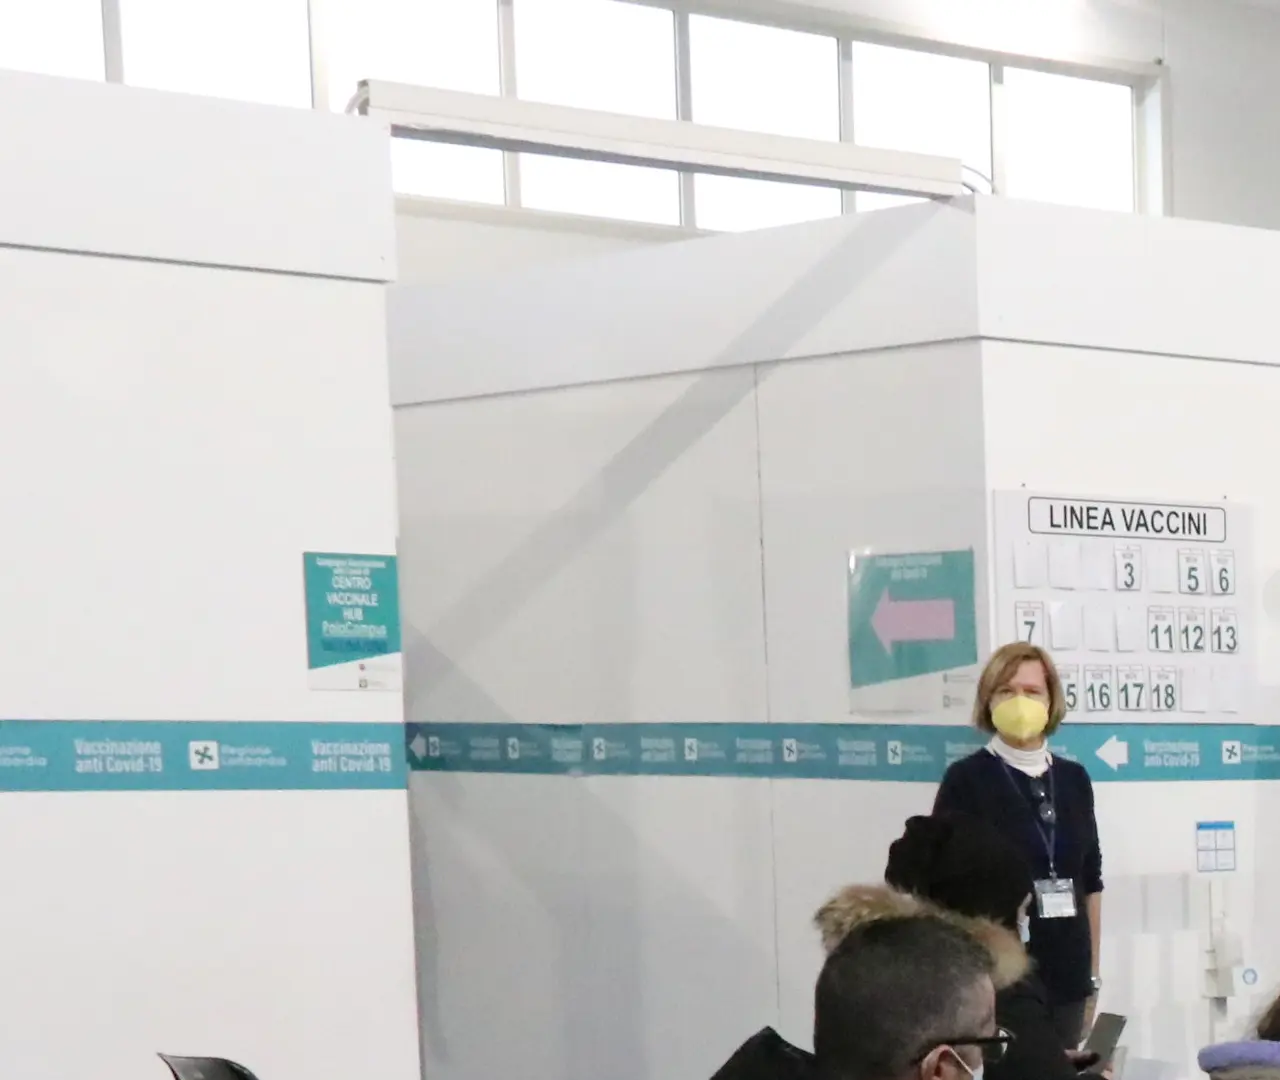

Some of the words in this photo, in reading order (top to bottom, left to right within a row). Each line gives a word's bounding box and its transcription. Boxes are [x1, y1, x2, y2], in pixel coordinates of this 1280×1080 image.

[1049, 505, 1115, 531] LINEA
[1122, 508, 1206, 535] VACCINI
[1124, 562, 1135, 588] 3
[1187, 566, 1199, 591] 5
[1219, 567, 1229, 592] 6
[1024, 621, 1036, 643] 7
[1151, 624, 1173, 649] 11
[1182, 625, 1204, 650] 12
[1213, 625, 1237, 650] 13
[1066, 684, 1077, 708] 5
[1087, 683, 1110, 708] 16
[1120, 683, 1144, 708] 17
[1153, 684, 1175, 708] 18
[74, 739, 161, 755] Vaccinazione
[311, 740, 390, 756] Vaccinazione
[75, 757, 103, 772] anti
[106, 757, 162, 773] Covid-19
[312, 757, 337, 772] anti
[340, 757, 391, 772] Covid-19
